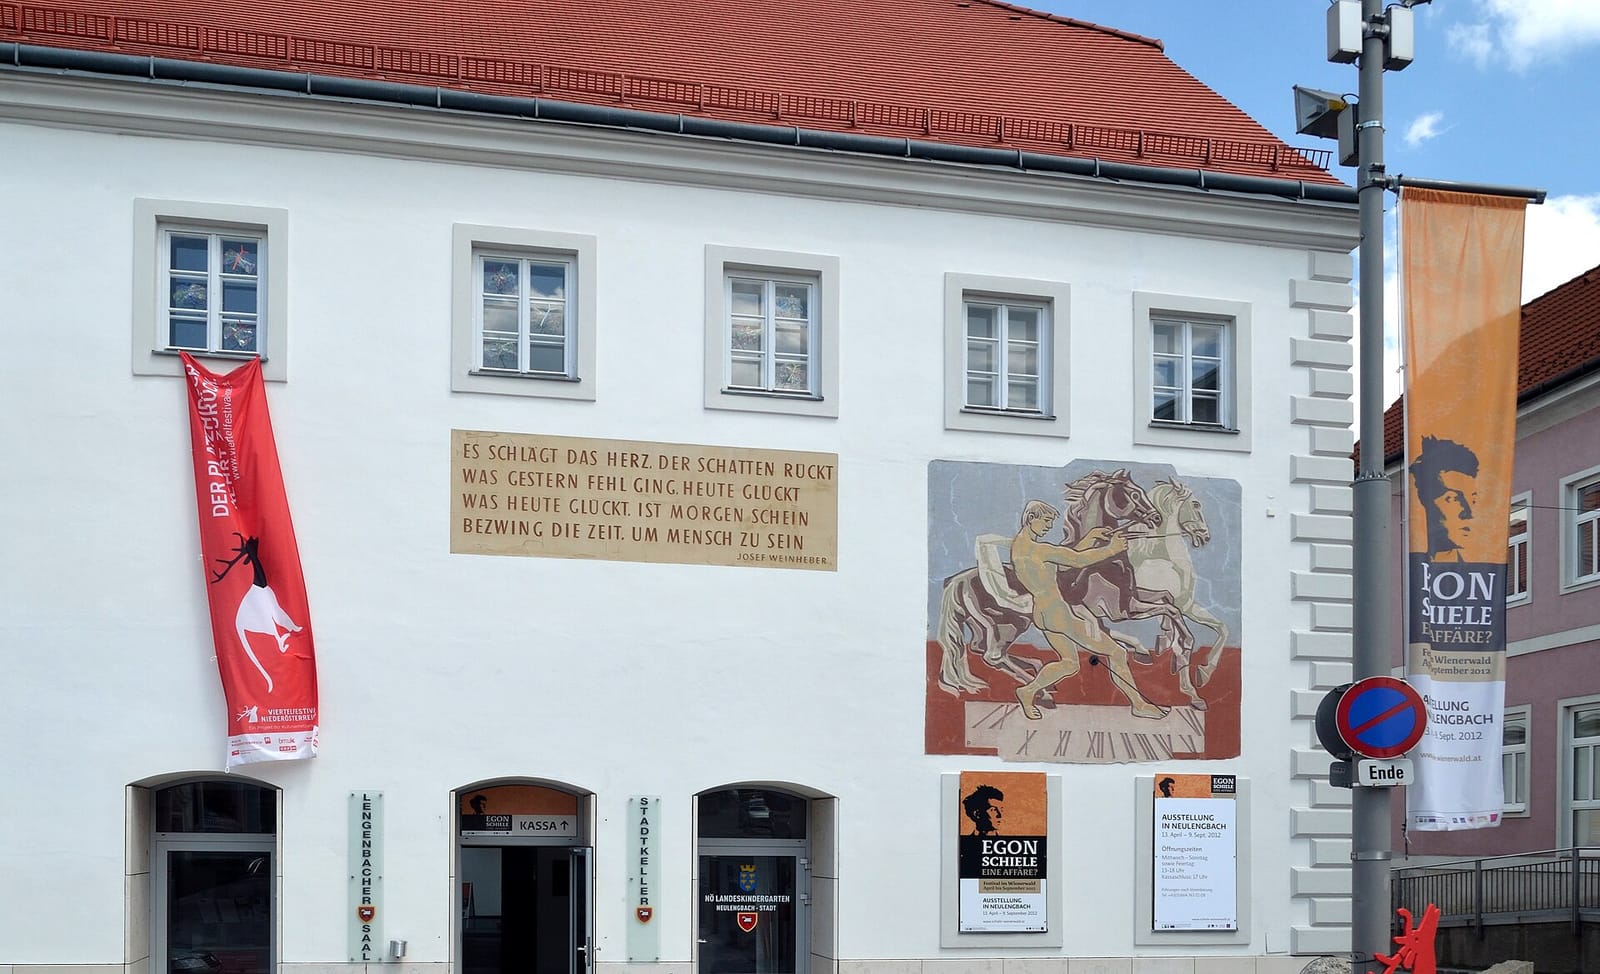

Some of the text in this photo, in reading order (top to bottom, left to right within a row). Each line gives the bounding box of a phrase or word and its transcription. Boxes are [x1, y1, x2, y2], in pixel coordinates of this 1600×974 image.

[463, 443, 480, 459] ES
[488, 444, 559, 463] SCHLÄGT
[567, 449, 598, 466] DAS
[607, 452, 653, 470] HERZ.
[658, 455, 690, 472] DER
[697, 457, 775, 477] SCHATTEN
[462, 468, 498, 485] WAS
[508, 470, 579, 489] GESTERN
[588, 475, 627, 492] FEHL
[633, 477, 679, 495] GING.
[683, 480, 734, 498] HEUTE
[210, 481, 230, 518] DER
[462, 493, 498, 510] WAS
[507, 495, 561, 513] HEUTE
[638, 502, 662, 519] IST
[670, 504, 744, 522] MORGEN
[751, 508, 809, 527] SCHEIN
[463, 517, 803, 550] BEZWING DIE ZEIT. UM MENSCH ZU SEIN
[737, 553, 767, 562] JOSEF
[1421, 562, 1496, 601] EON
[1434, 655, 1491, 665] Wienerwald
[1016, 729, 1038, 756] X
[1086, 730, 1104, 758] XII
[1458, 731, 1483, 741] 2012
[1369, 764, 1404, 780] Ende
[520, 821, 557, 831] KASSA
[1161, 822, 1227, 830] IN NEULENGBACH
[1170, 831, 1183, 839] April
[639, 797, 649, 905] STADTKELLER
[982, 840, 1039, 855] EGON
[982, 856, 1038, 867] SCHIELE
[361, 793, 372, 961] LENGENBACHER SAAL
[982, 867, 1039, 876] EINE AFFÄRE?
[704, 893, 790, 903] NÖ LANDESKINDERGARTEN
